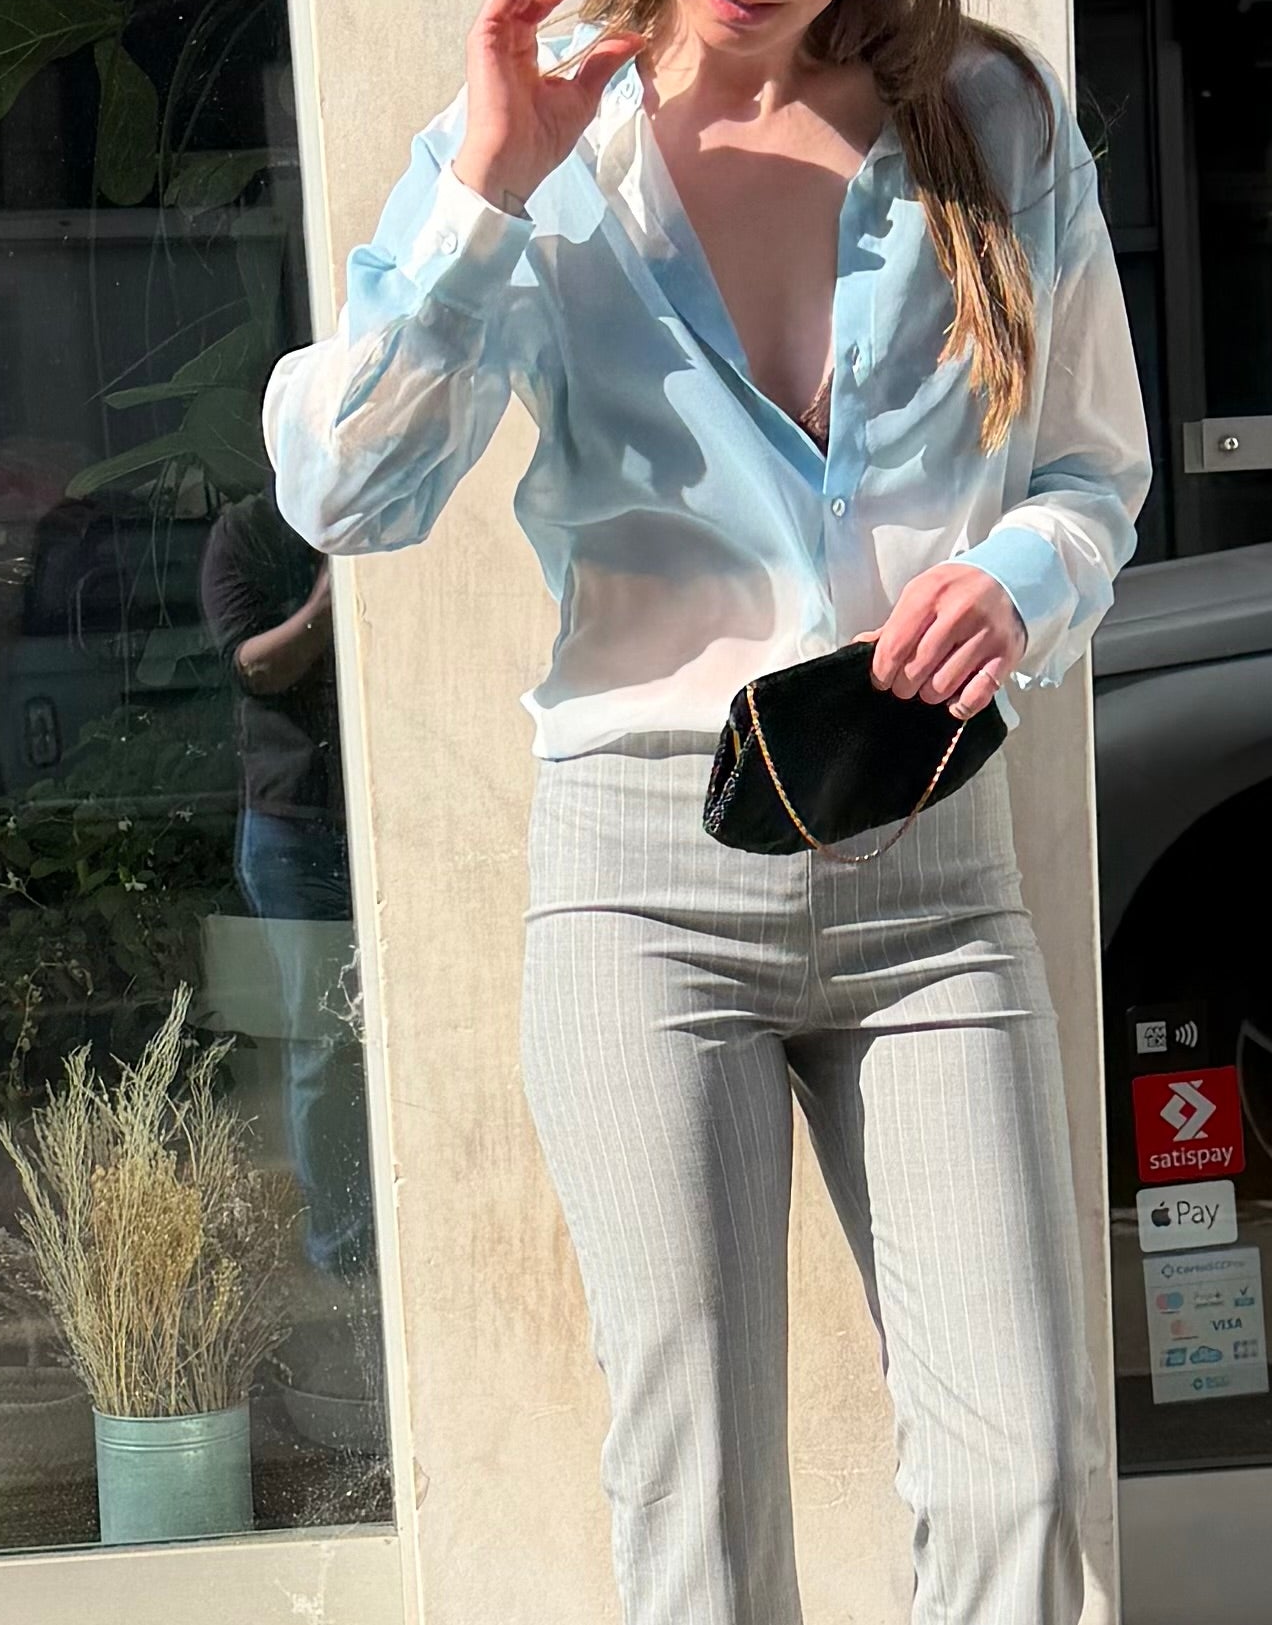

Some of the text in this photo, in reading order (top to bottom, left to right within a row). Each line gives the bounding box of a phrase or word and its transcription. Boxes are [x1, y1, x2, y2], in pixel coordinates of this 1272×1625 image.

[1149, 1146, 1233, 1170] satispay
[1177, 1201, 1219, 1230] Pay
[1212, 1318, 1242, 1331] VISA
